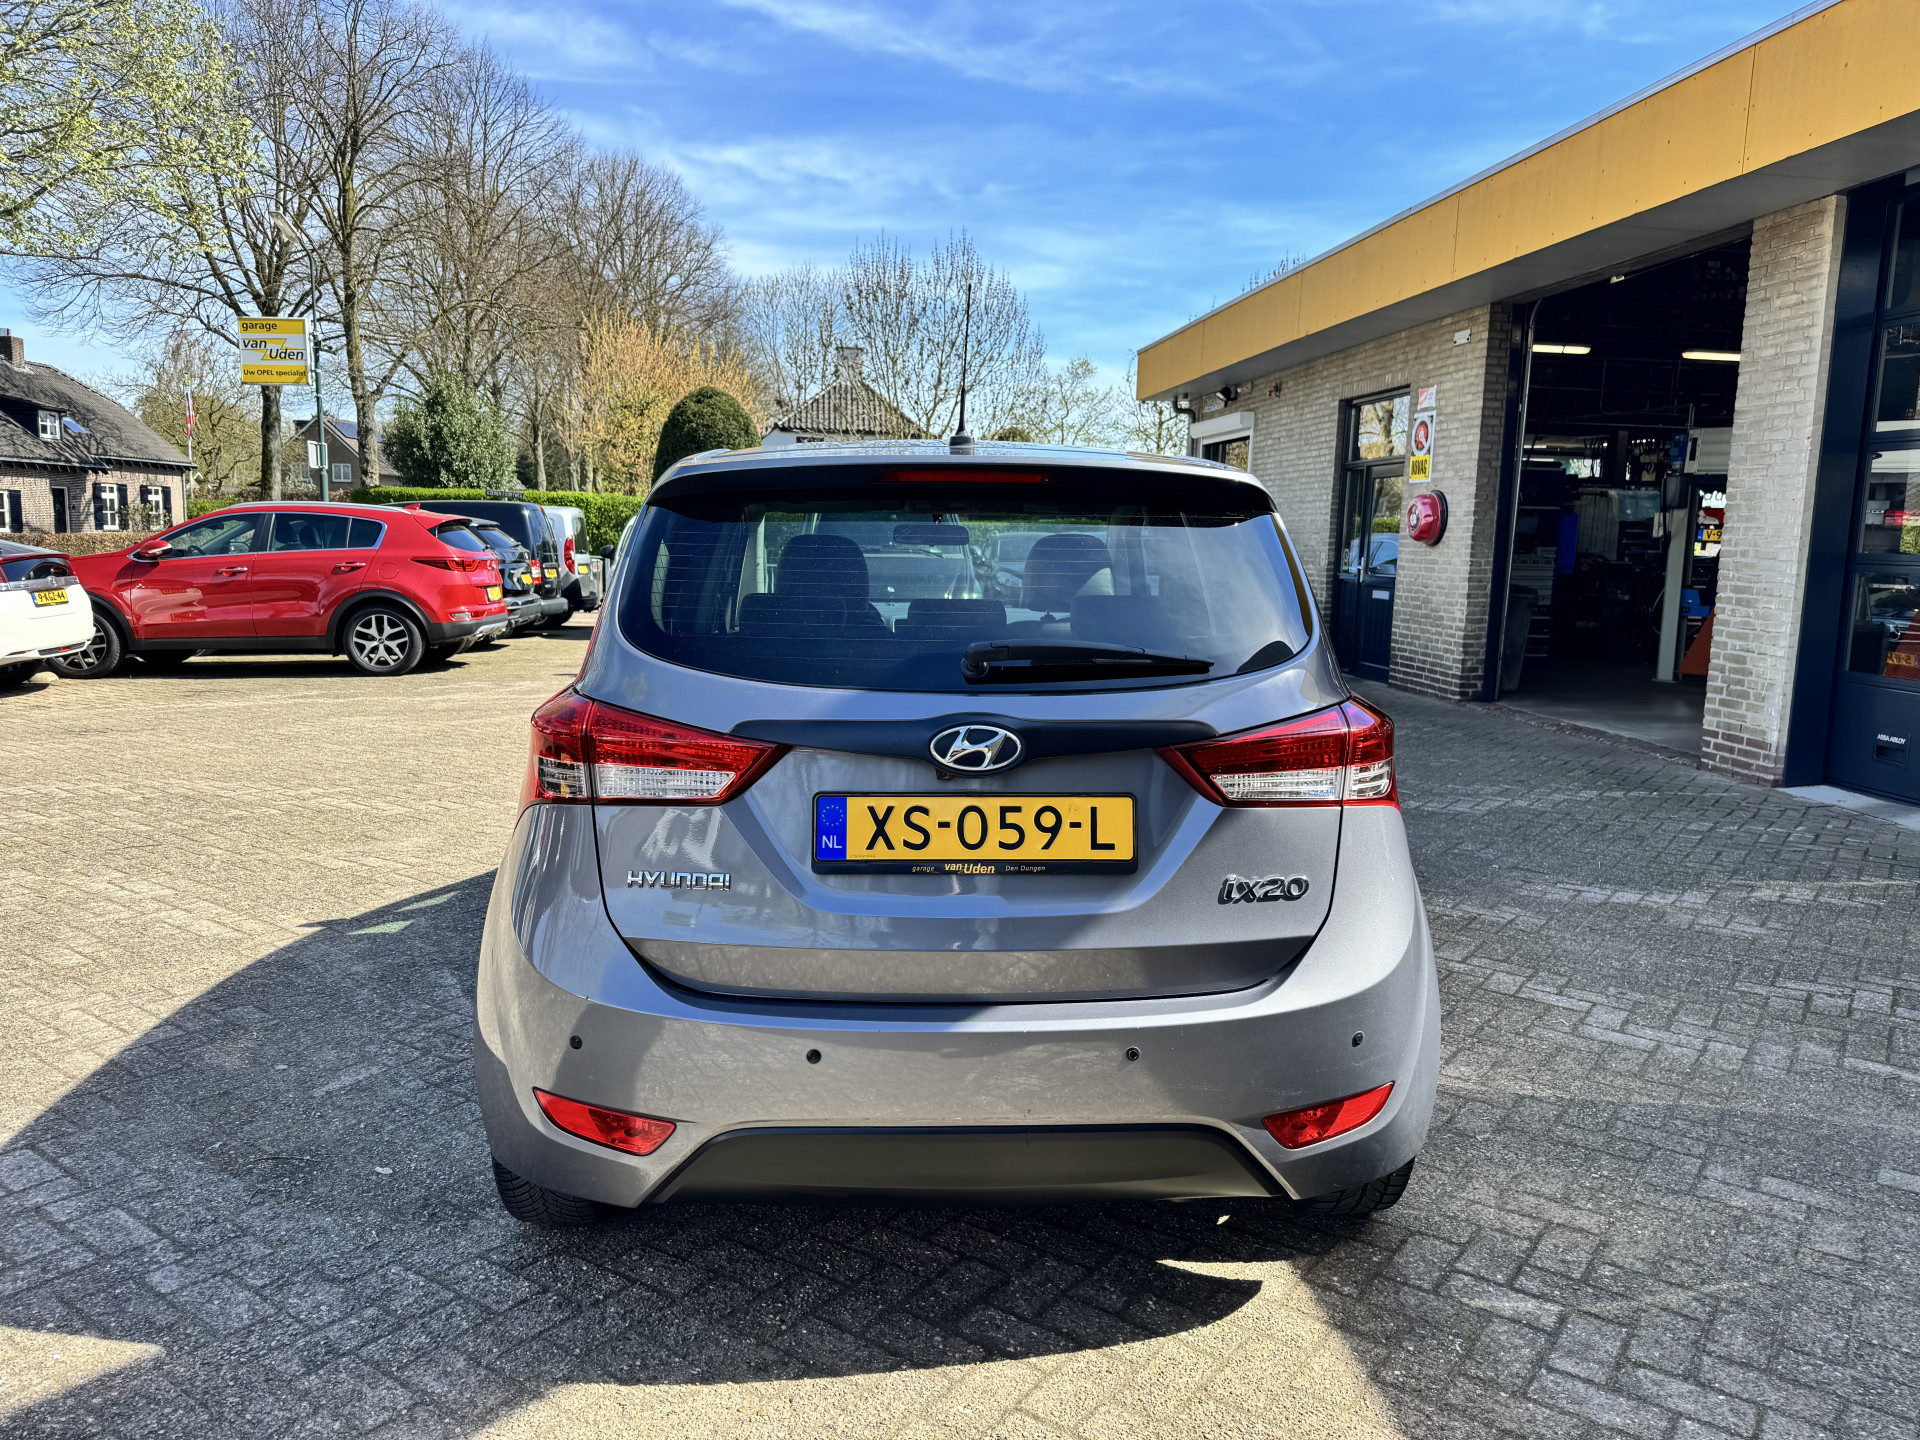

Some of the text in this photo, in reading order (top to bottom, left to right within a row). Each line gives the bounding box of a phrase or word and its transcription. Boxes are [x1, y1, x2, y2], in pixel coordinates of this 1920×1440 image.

[241, 322, 278, 332] garage
[243, 339, 304, 360] van Uden
[1411, 458, 1427, 476] BOVAG
[821, 804, 1117, 851] NL XS-059-L
[911, 865, 935, 873] garage
[944, 863, 962, 871] van
[963, 862, 995, 874] Uden
[1020, 865, 1046, 873] Dungen
[626, 870, 732, 891] HYUNDAI
[1217, 873, 1310, 905] ix20
